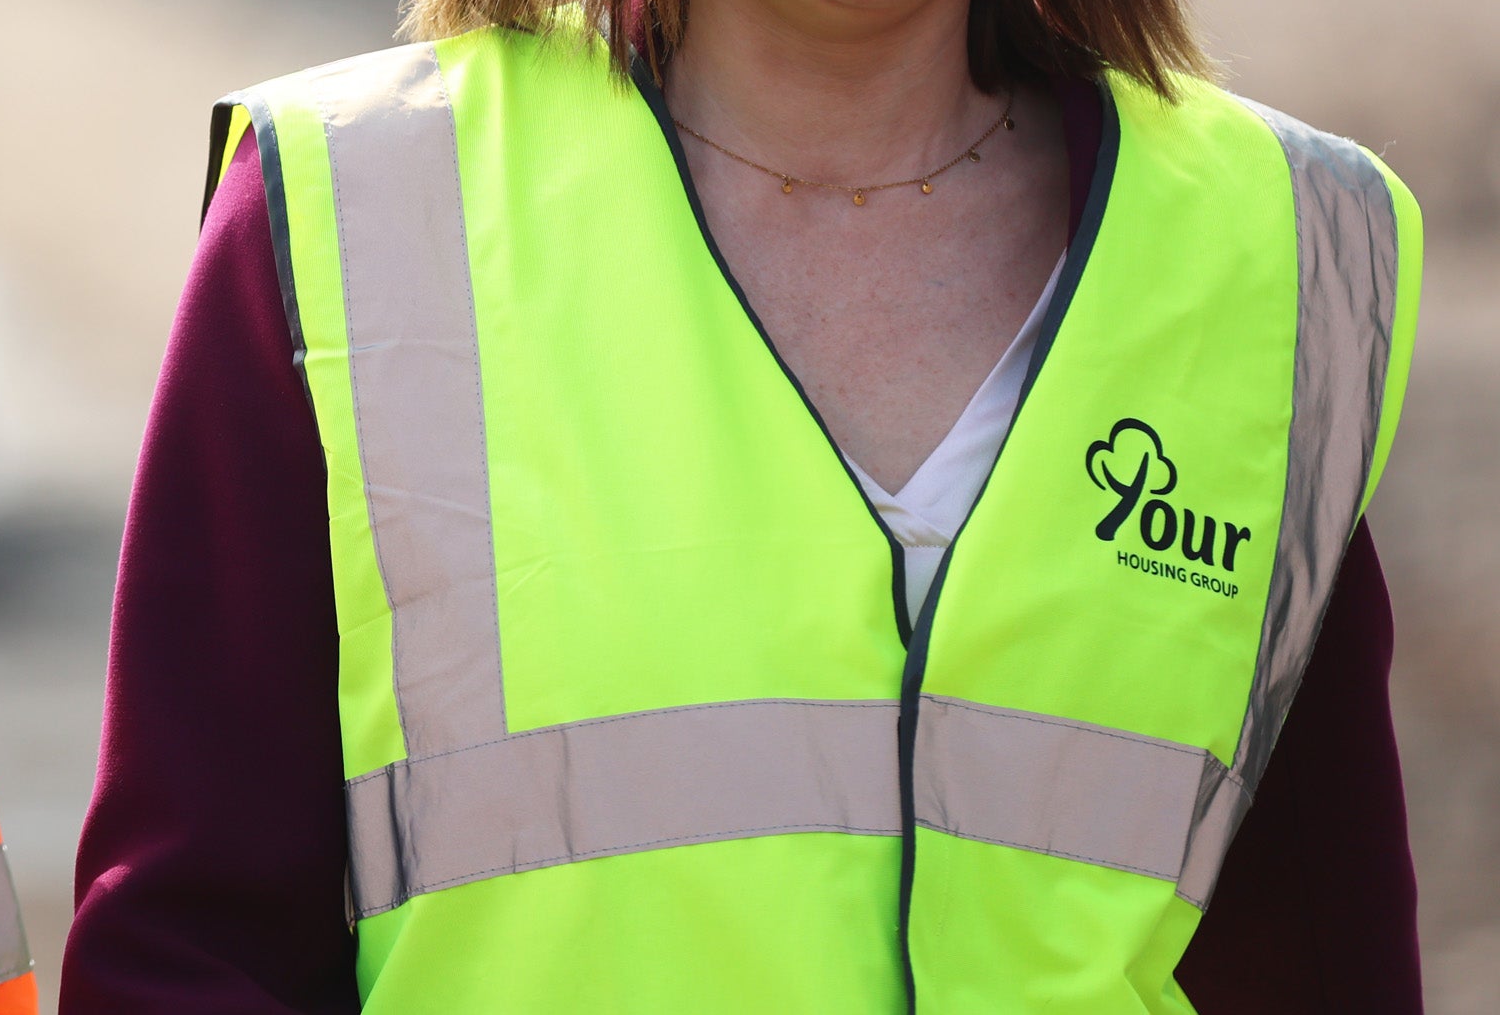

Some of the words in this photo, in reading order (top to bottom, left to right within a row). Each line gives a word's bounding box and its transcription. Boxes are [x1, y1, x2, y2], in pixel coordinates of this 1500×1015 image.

[1095, 451, 1251, 572] Your
[1117, 550, 1187, 583] HOUSING
[1190, 572, 1239, 599] GROUP
